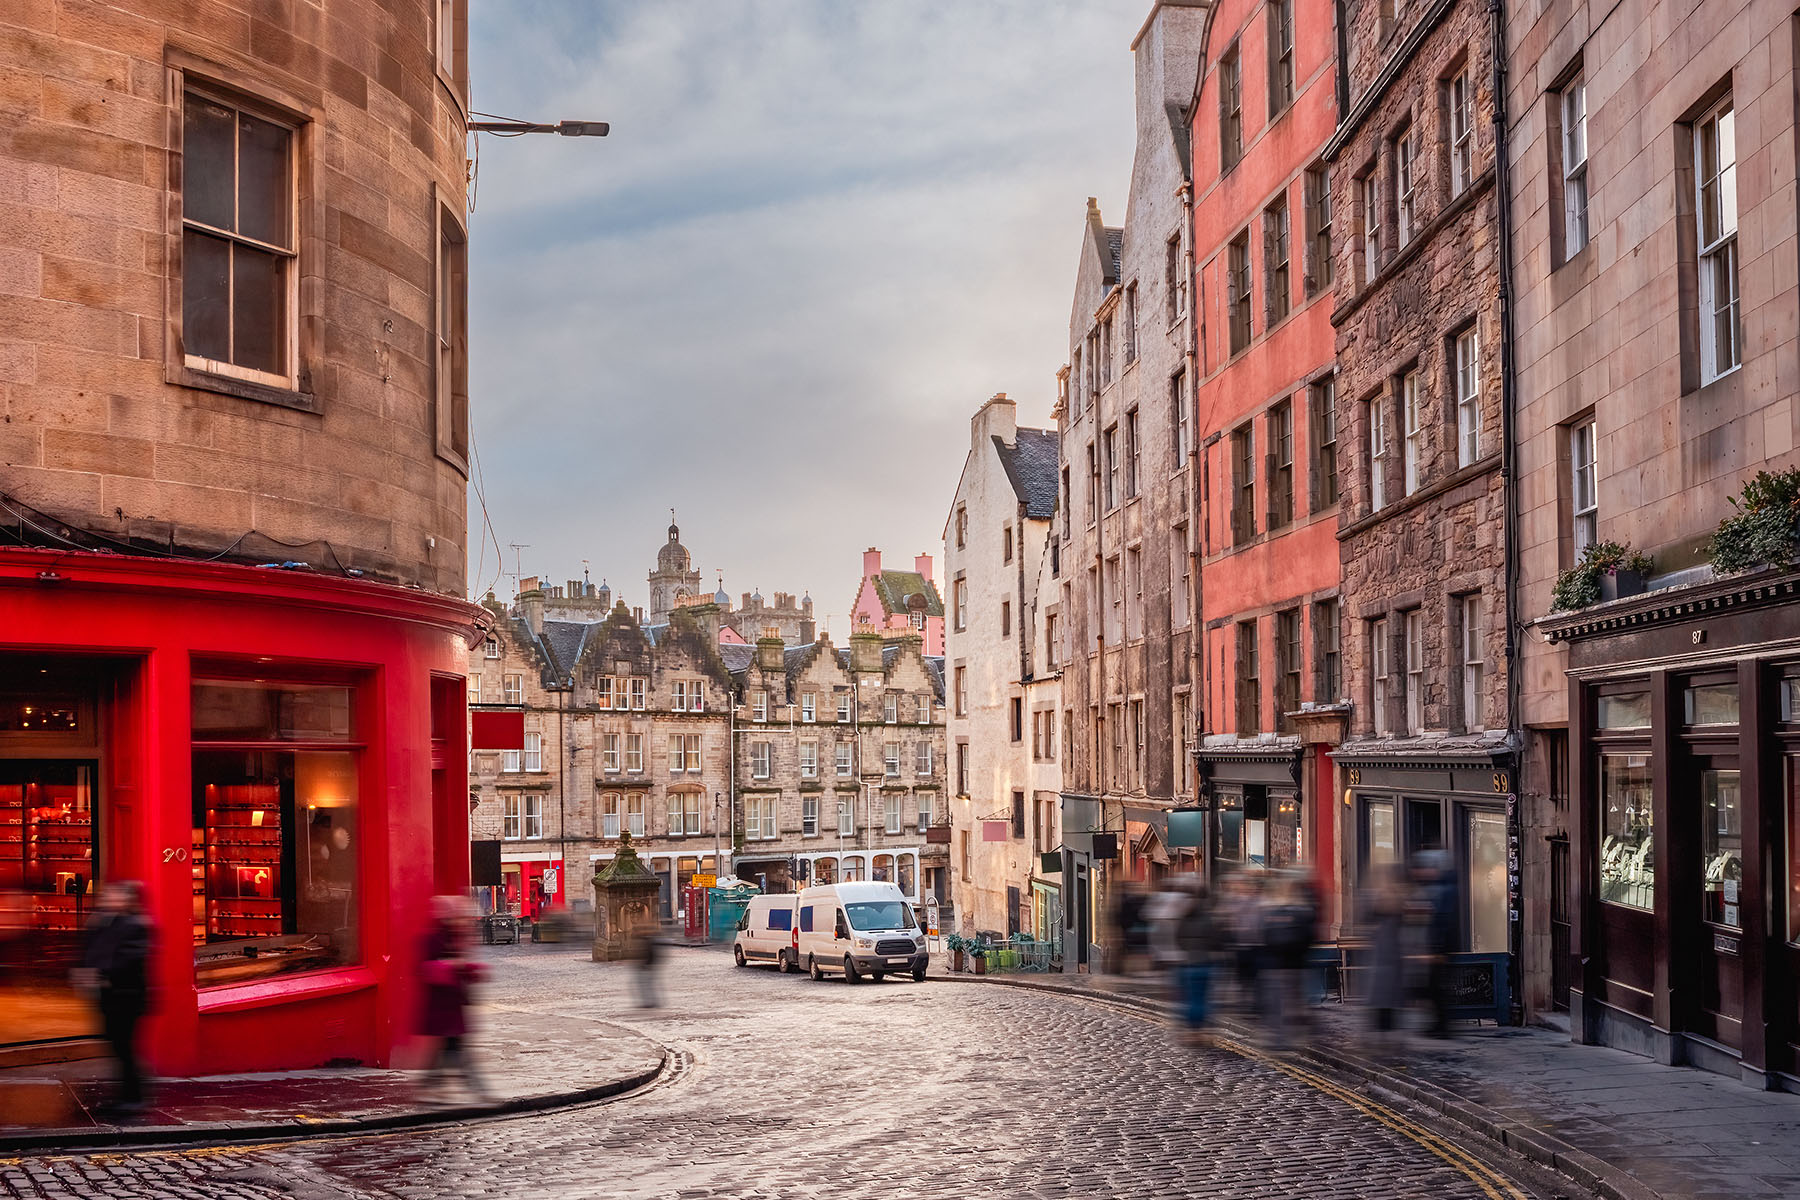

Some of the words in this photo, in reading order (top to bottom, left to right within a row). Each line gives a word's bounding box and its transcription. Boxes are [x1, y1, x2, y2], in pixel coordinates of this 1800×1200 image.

[1692, 630, 1702, 644] 87
[1350, 769, 1360, 785] 89
[1493, 773, 1508, 793] 89
[162, 848, 187, 863] 90
